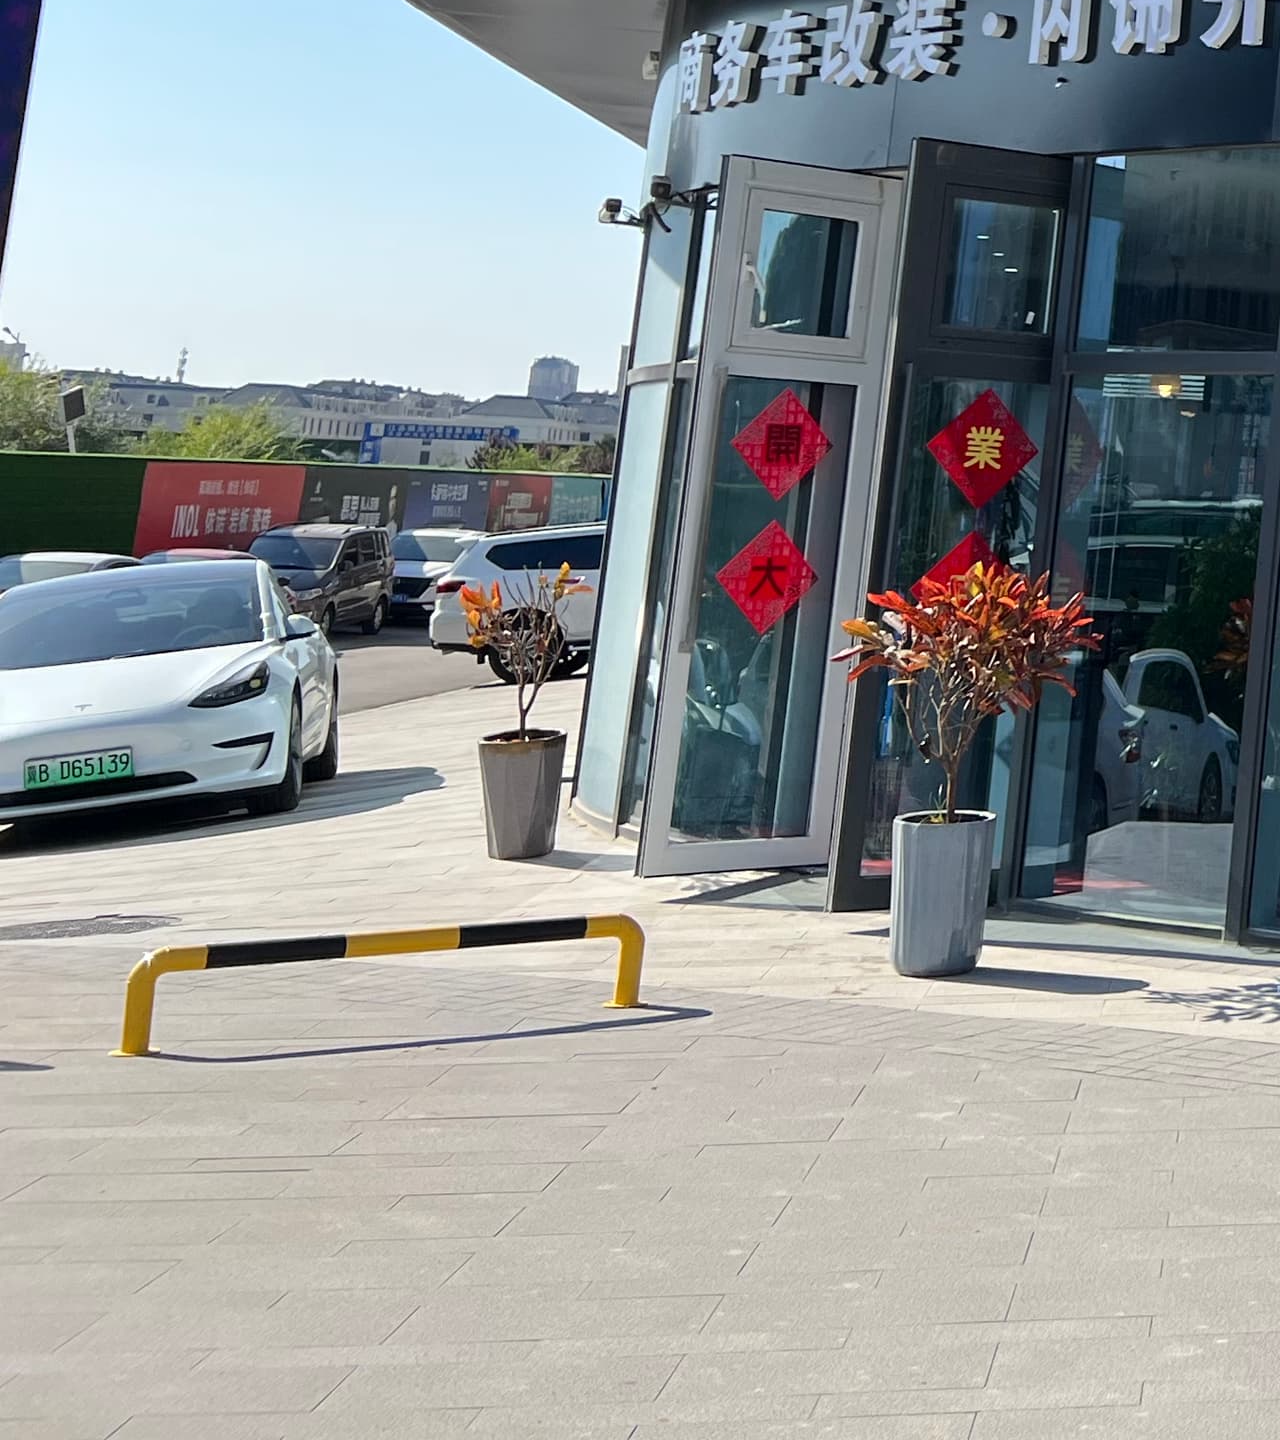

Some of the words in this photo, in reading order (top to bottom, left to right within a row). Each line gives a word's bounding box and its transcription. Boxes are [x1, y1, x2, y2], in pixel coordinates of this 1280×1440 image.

[763, 421, 803, 463] 開
[963, 425, 1005, 470] 業
[749, 556, 788, 598] 大
